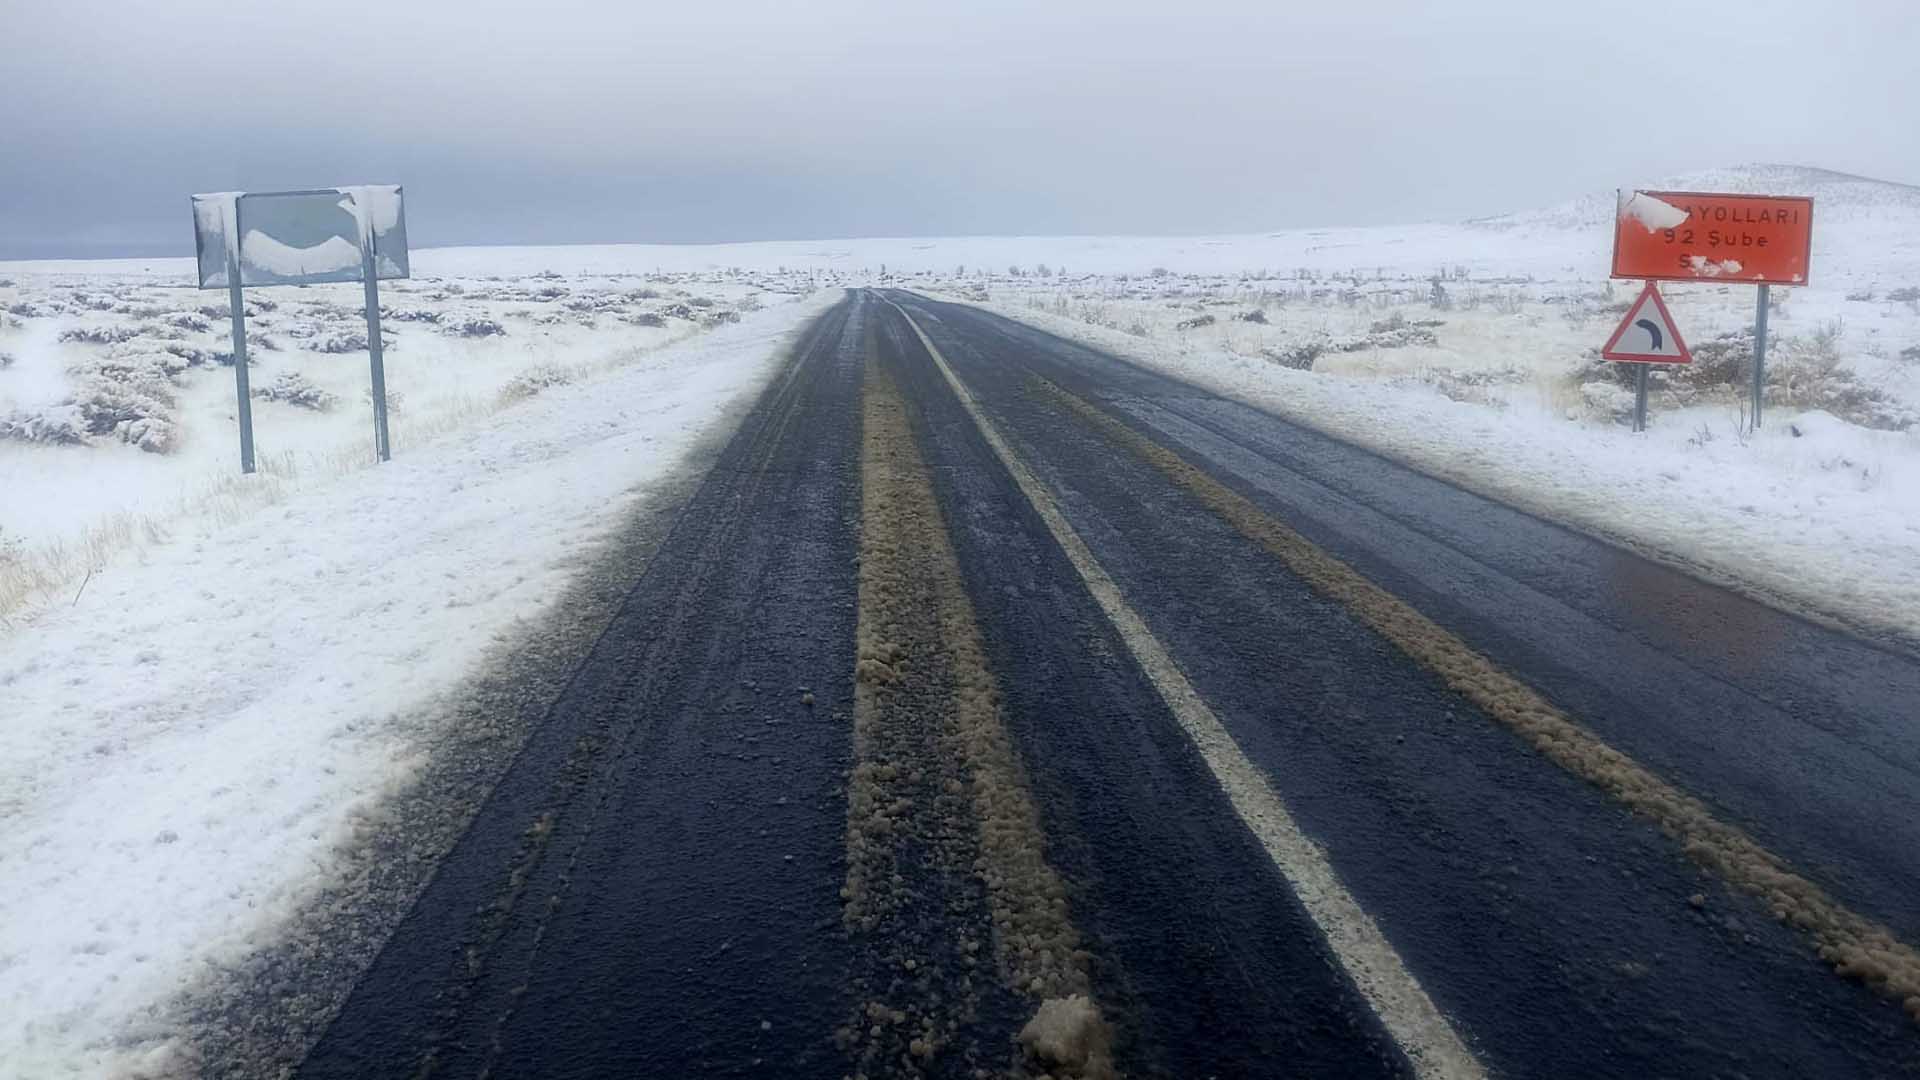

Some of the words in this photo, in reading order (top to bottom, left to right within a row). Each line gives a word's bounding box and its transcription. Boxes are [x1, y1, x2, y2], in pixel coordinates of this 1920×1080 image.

[1630, 206, 1798, 225] AYOLLARI
[1664, 229, 1694, 244] 92
[1708, 230, 1769, 248] Şube
